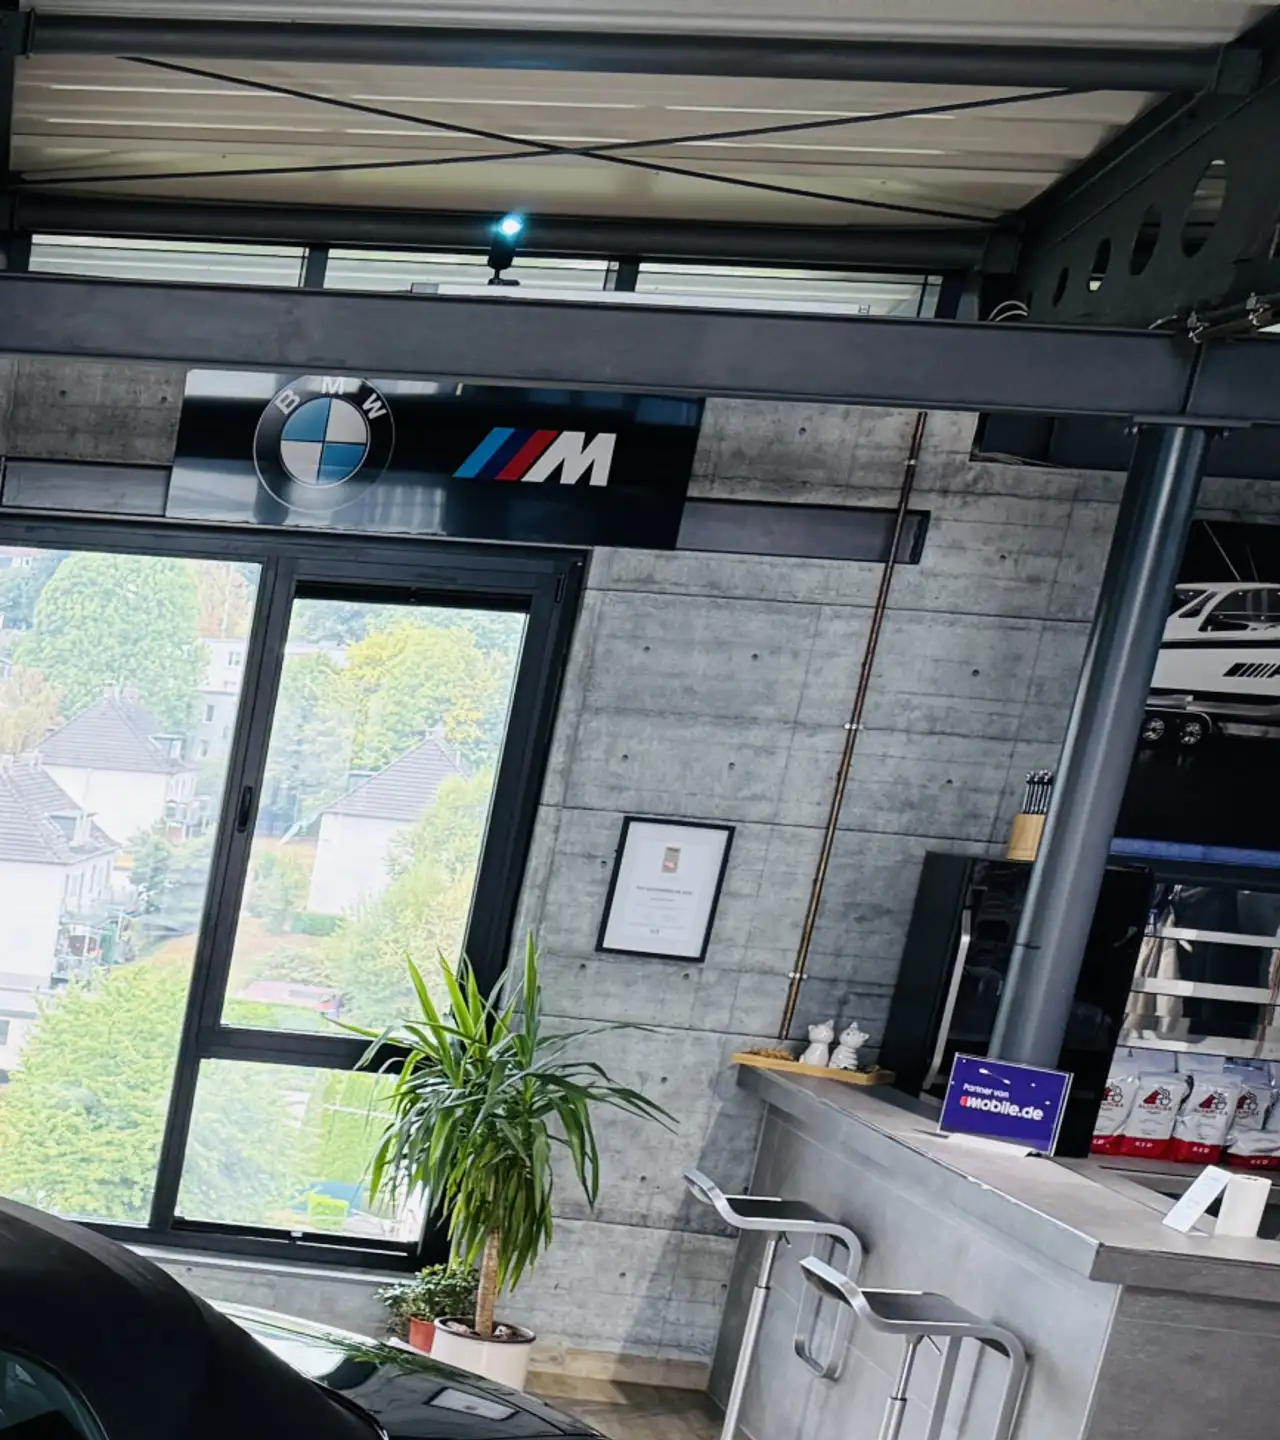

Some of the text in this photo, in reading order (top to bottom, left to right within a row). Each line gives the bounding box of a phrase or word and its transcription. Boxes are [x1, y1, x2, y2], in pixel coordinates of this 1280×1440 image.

[273, 375, 388, 420] BMW
[962, 1082, 992, 1096] Partner
[960, 1095, 1044, 1120] mobile.de
